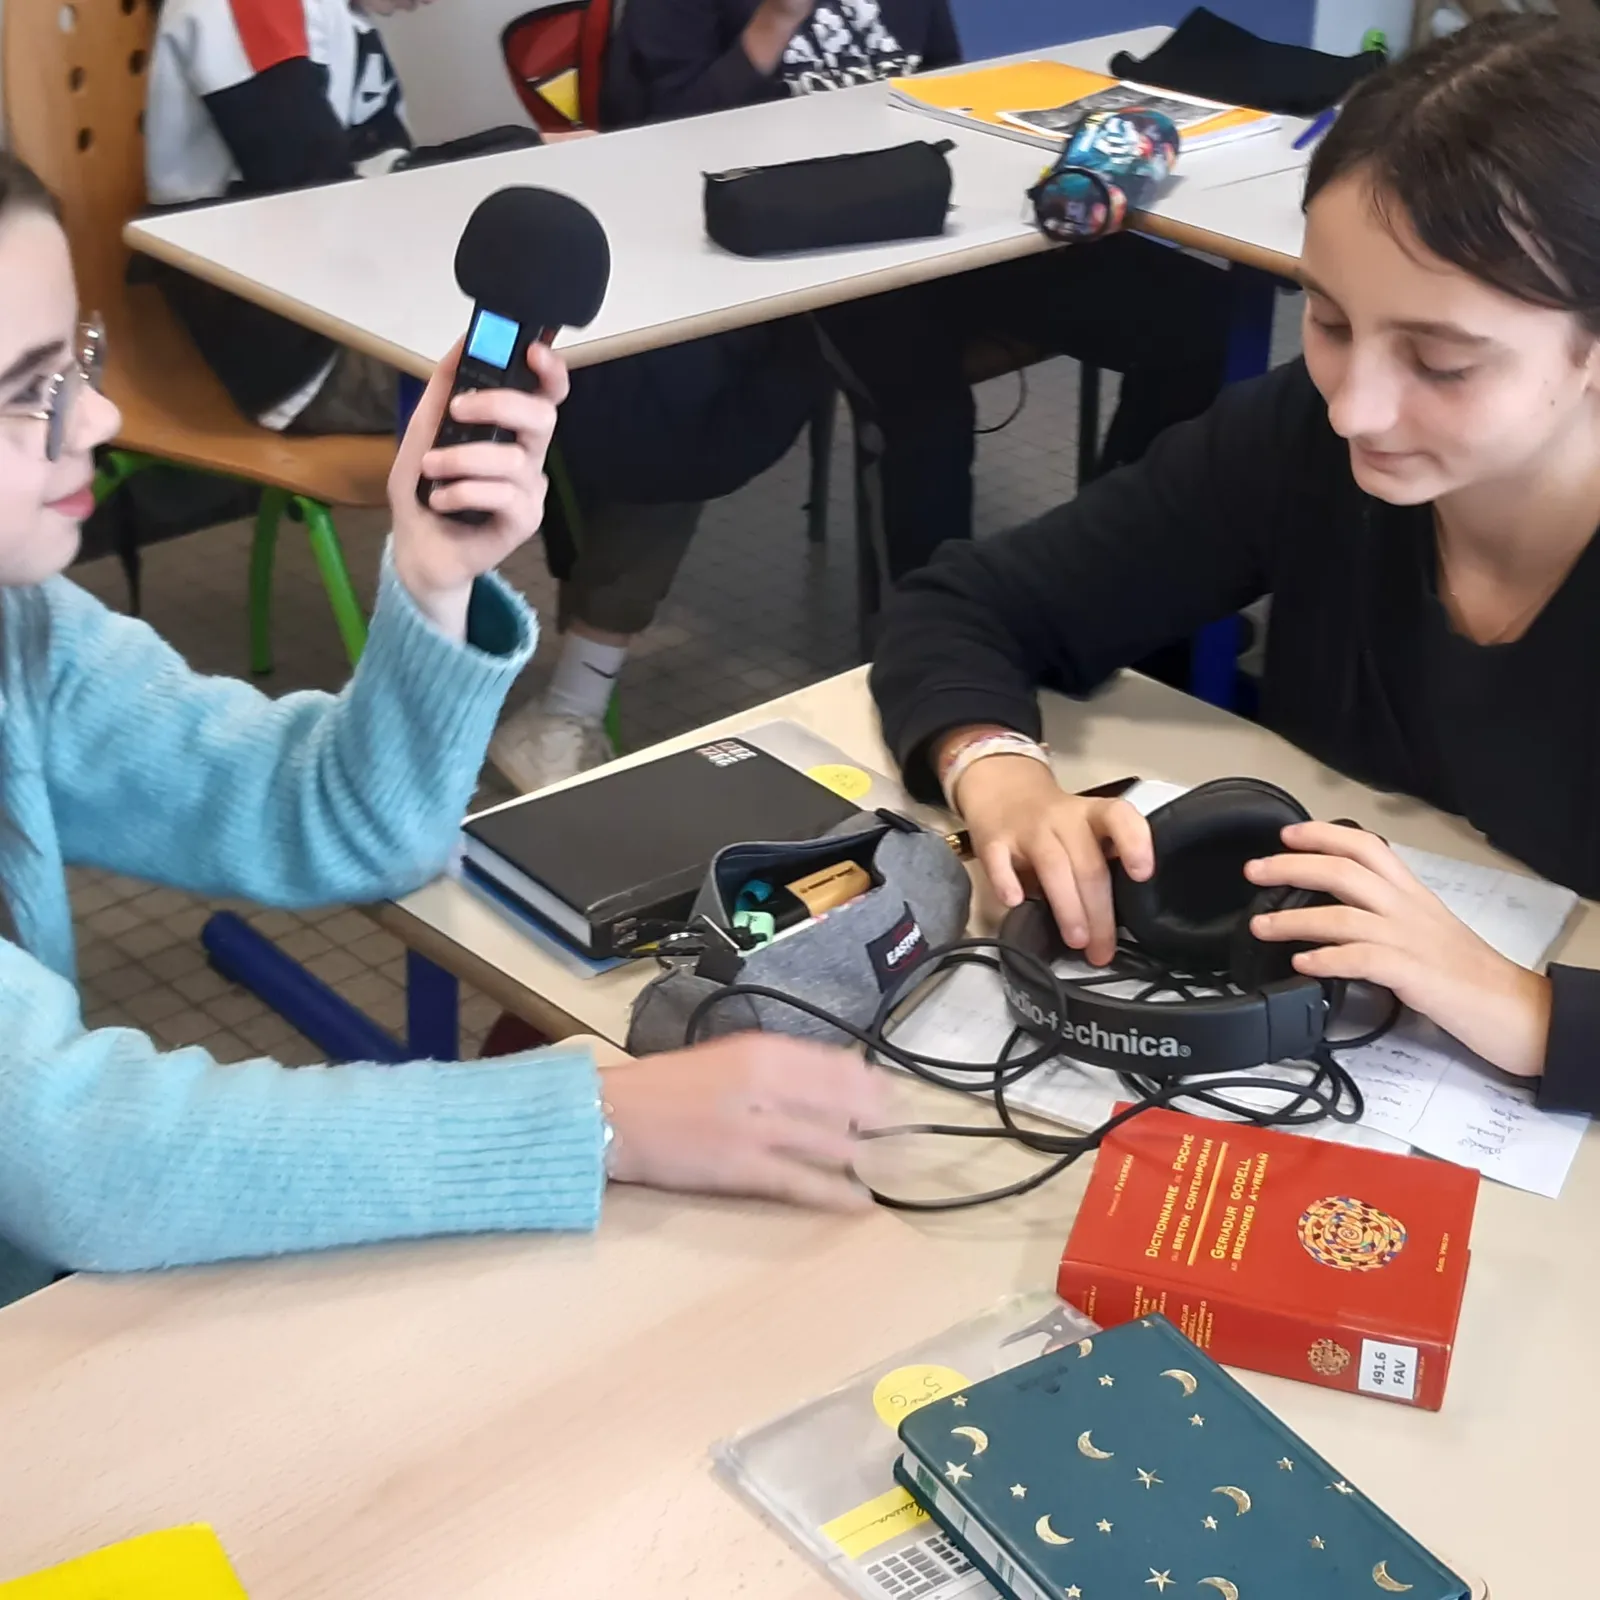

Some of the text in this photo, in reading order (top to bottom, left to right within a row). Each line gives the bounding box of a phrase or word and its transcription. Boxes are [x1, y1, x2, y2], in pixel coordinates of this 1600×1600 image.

[1145, 1184, 1180, 1258] DICTIONNAIRE
[1172, 1133, 1195, 1172] POCHE
[1172, 1214, 1192, 1251] BRETON
[1184, 1138, 1214, 1211] CONTEMPORAIN
[1210, 1158, 1252, 1260] GERIADUR GODELL
[1372, 1352, 1387, 1386] 491.6
[1393, 1360, 1406, 1386] FAV
